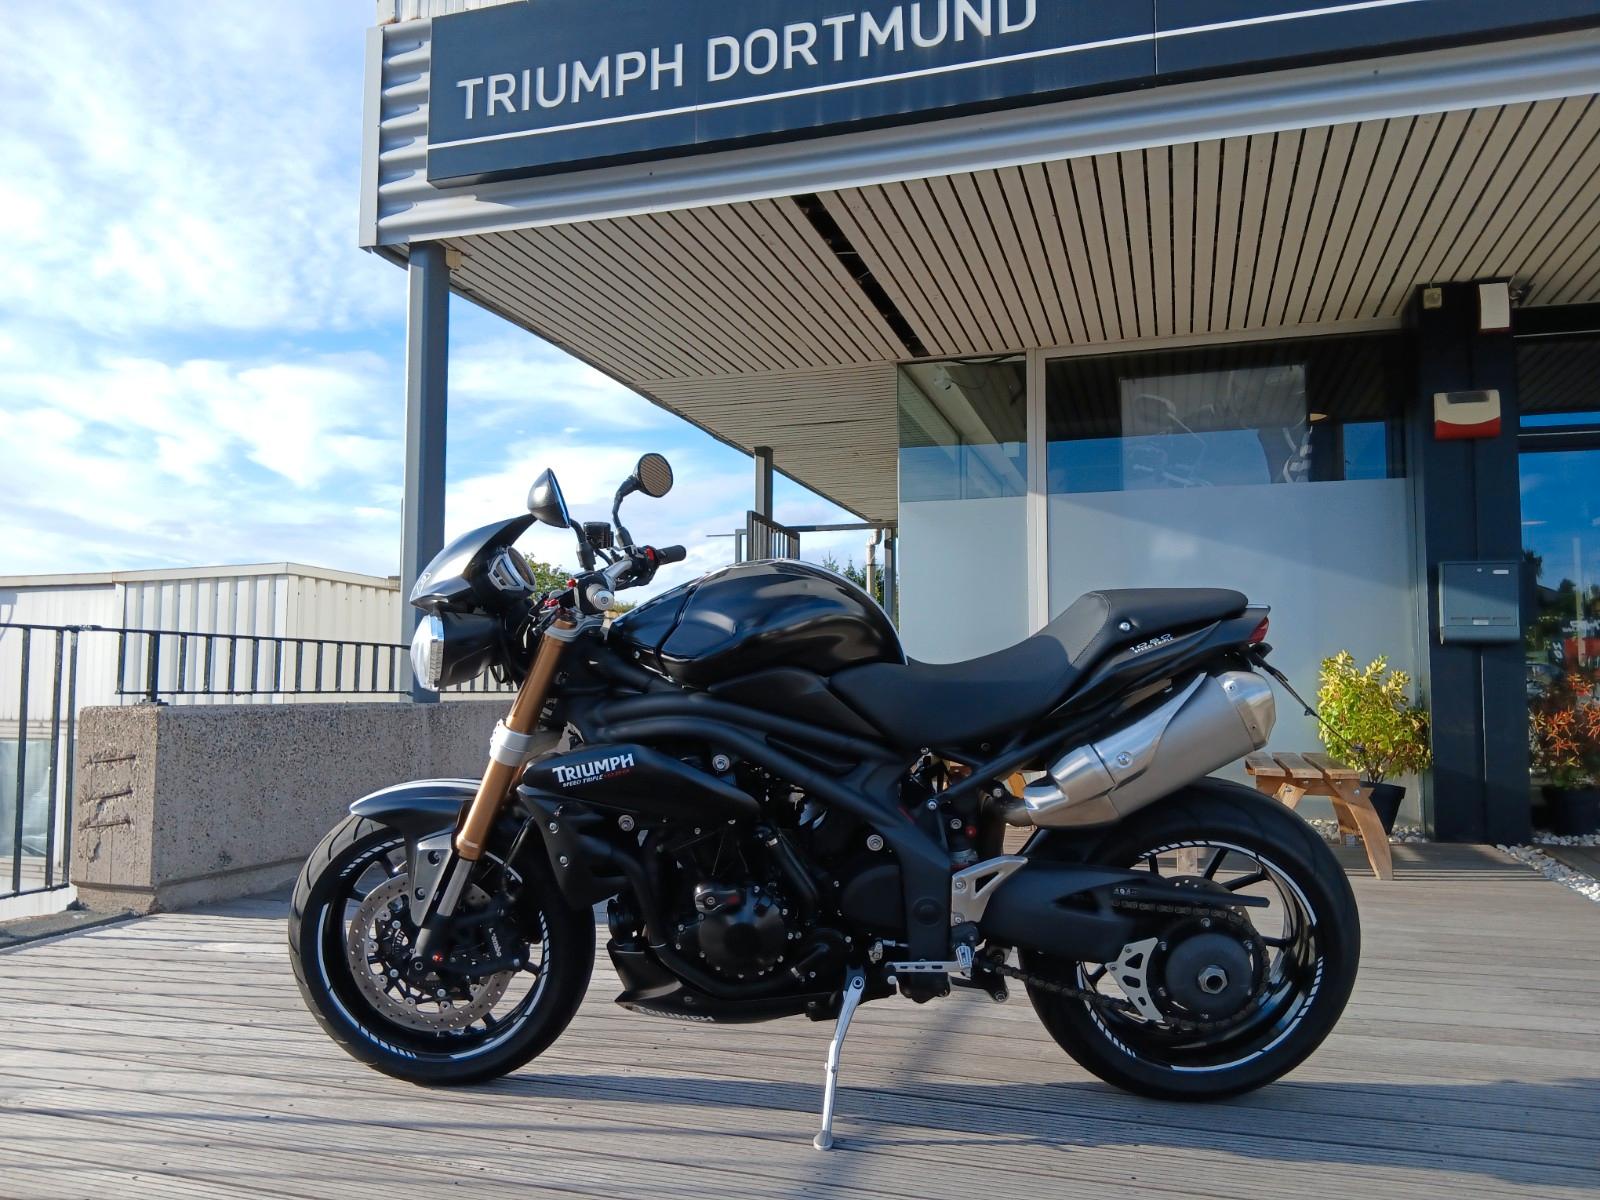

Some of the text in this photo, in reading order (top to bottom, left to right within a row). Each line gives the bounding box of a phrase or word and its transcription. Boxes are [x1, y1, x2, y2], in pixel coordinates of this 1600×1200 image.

[457, 0, 1036, 120] TRIUMPH DORTMUND
[552, 753, 635, 782] TRIUMPH
[562, 779, 581, 787] SPEED
[583, 774, 604, 784] TRIPLE
